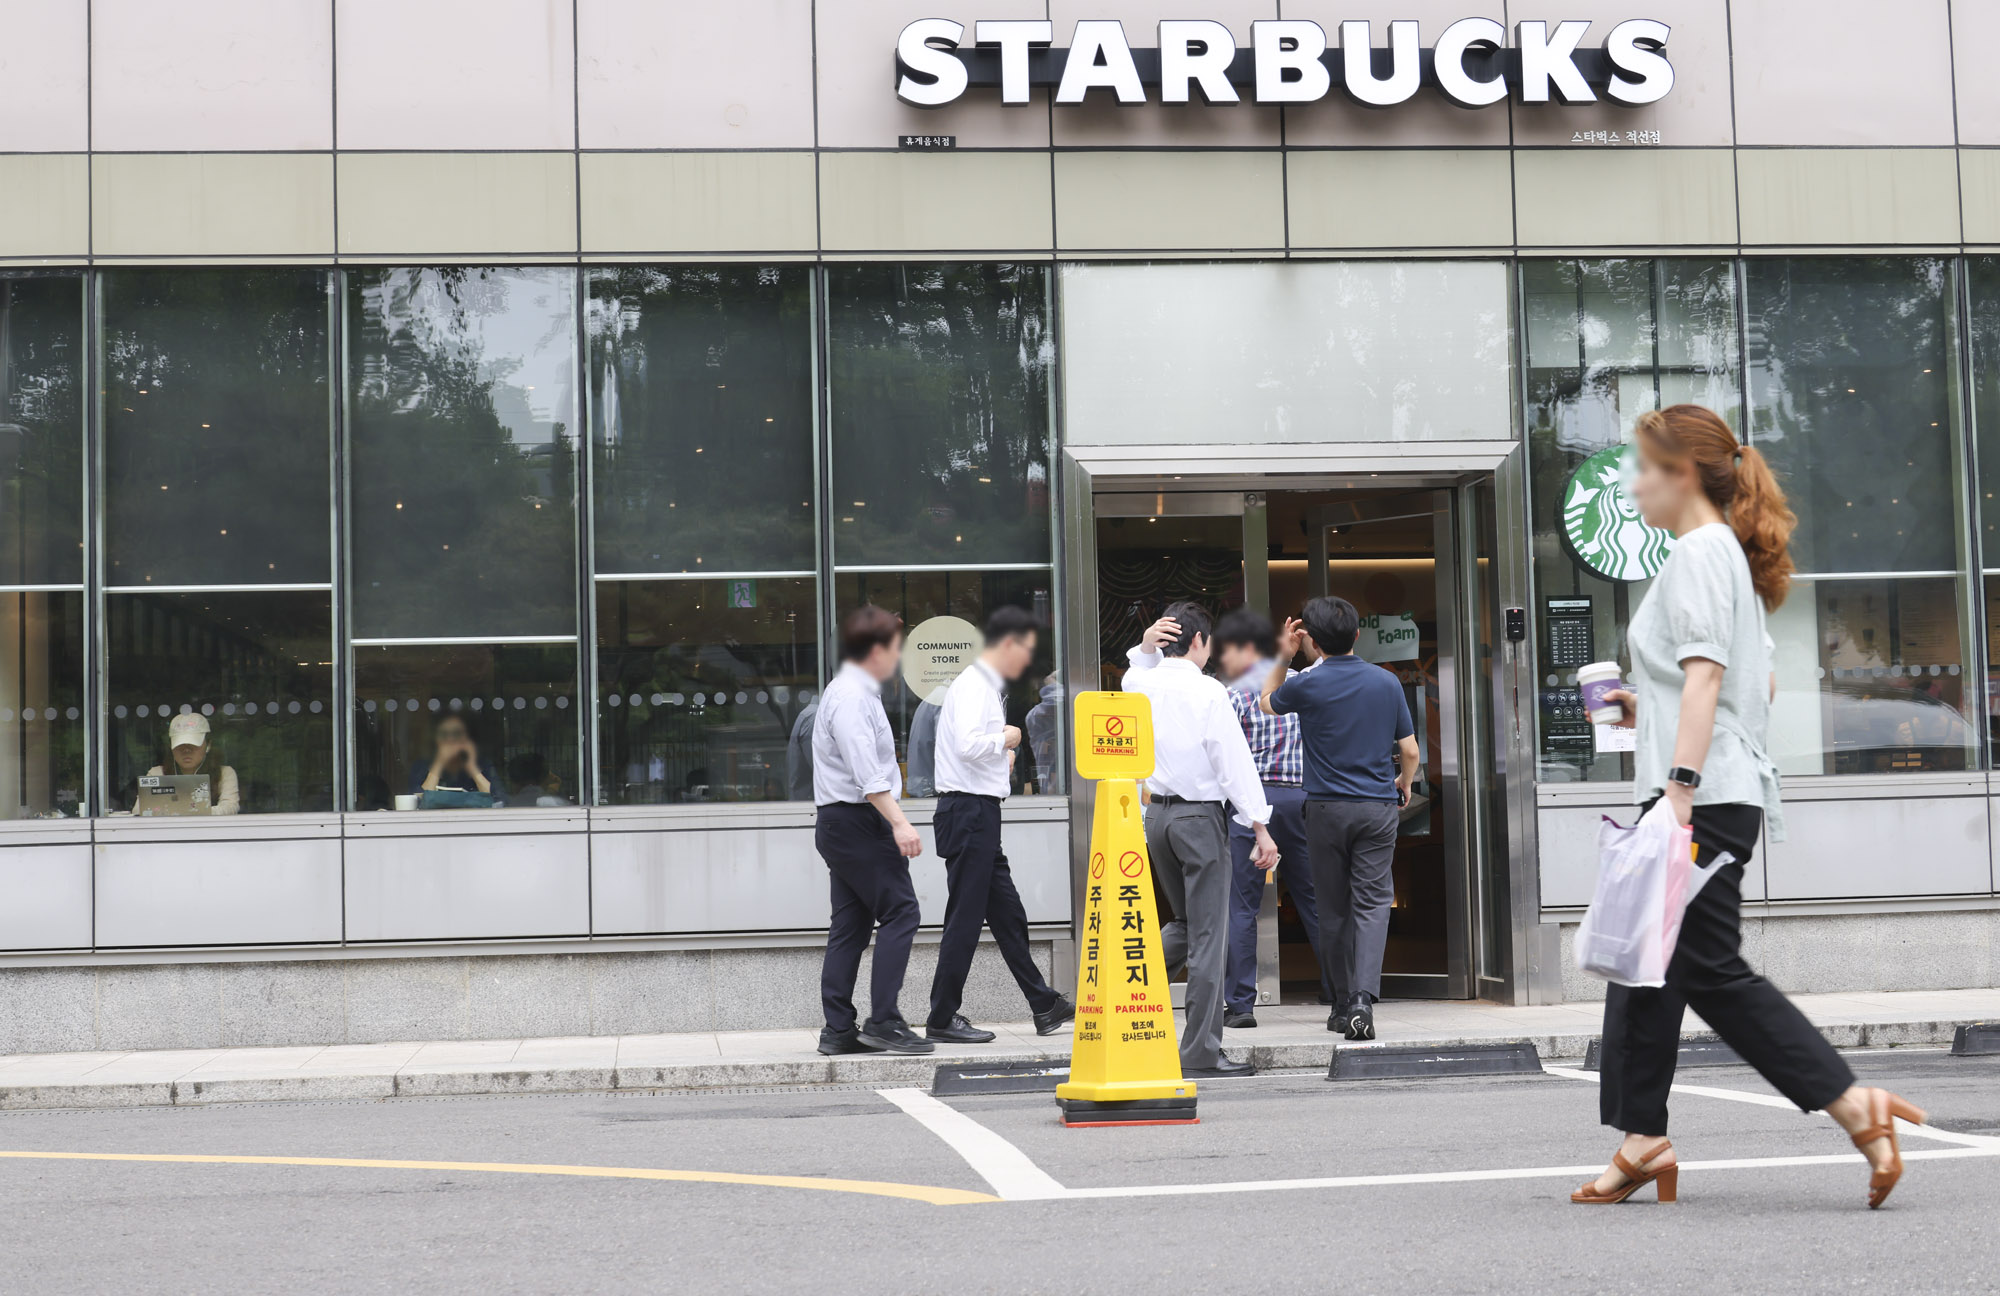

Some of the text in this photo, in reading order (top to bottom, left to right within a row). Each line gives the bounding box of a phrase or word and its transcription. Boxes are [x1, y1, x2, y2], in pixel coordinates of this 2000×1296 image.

[897, 17, 1675, 106] STARBUCKS
[905, 136, 950, 147] 휴게음식점
[1571, 130, 1661, 144] 스타벅스 적선점
[1358, 612, 1380, 629] old
[1377, 628, 1416, 645] Foam
[931, 655, 960, 664] STORE
[1097, 737, 1133, 746] 주차금지
[1086, 885, 1102, 988] 주차금지
[1118, 885, 1148, 986] 주차금지
[1087, 994, 1095, 1002] NO
[1131, 993, 1146, 1001] NO
[1079, 1006, 1103, 1014] PARKING
[1115, 1004, 1163, 1013] PARKING
[1085, 1021, 1096, 1030] 협조에
[1131, 1020, 1154, 1030] 협조에
[1079, 1032, 1102, 1040] 감사드립니다
[1121, 1030, 1166, 1042] 감사드립니다
